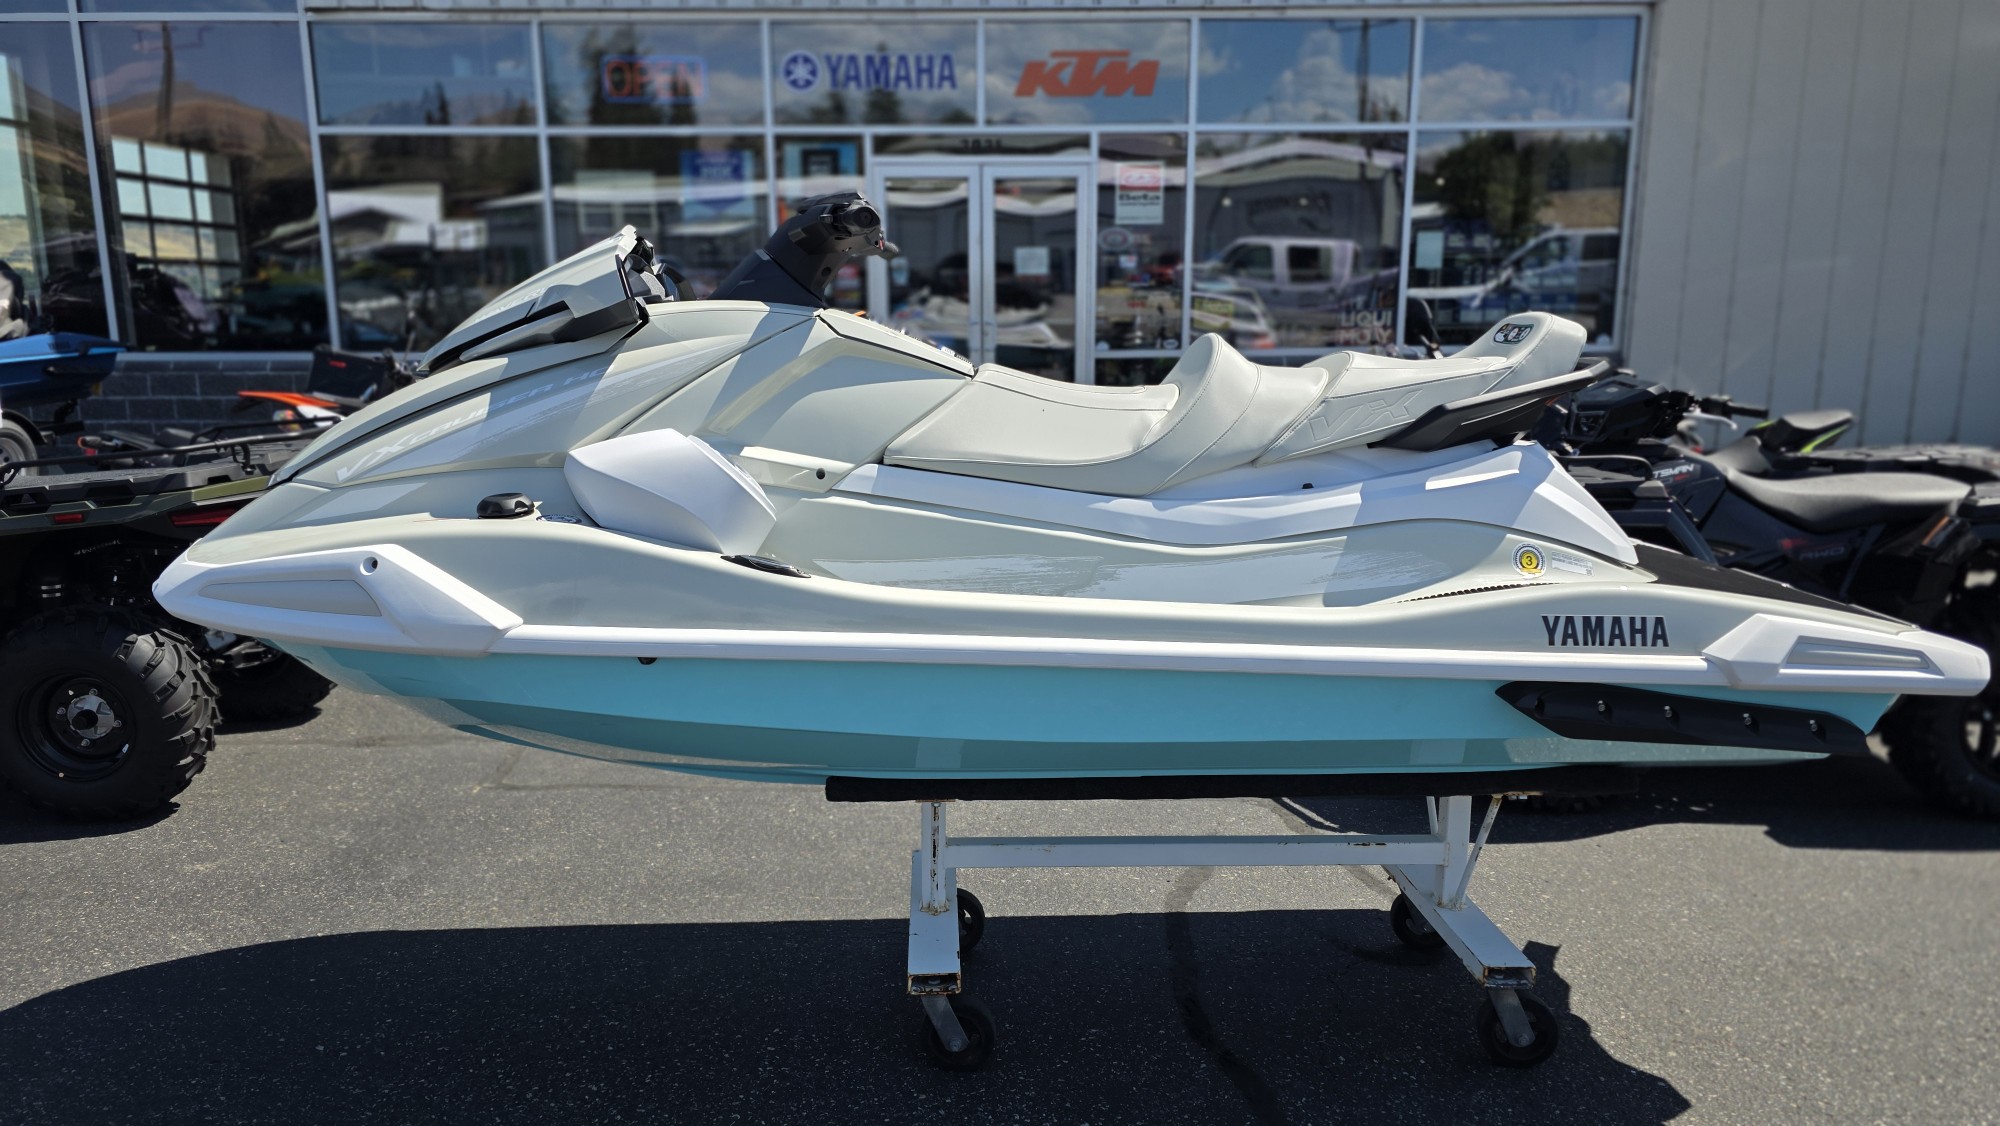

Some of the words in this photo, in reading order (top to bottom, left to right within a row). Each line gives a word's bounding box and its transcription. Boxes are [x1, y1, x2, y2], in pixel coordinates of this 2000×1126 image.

[606, 59, 703, 98] OPEN
[823, 53, 957, 90] YAMAHA
[1014, 50, 1160, 97] KTM
[1341, 310, 1393, 328] LIQUI
[1525, 555, 1533, 567] 3
[1541, 615, 1670, 648] YAMAHA
